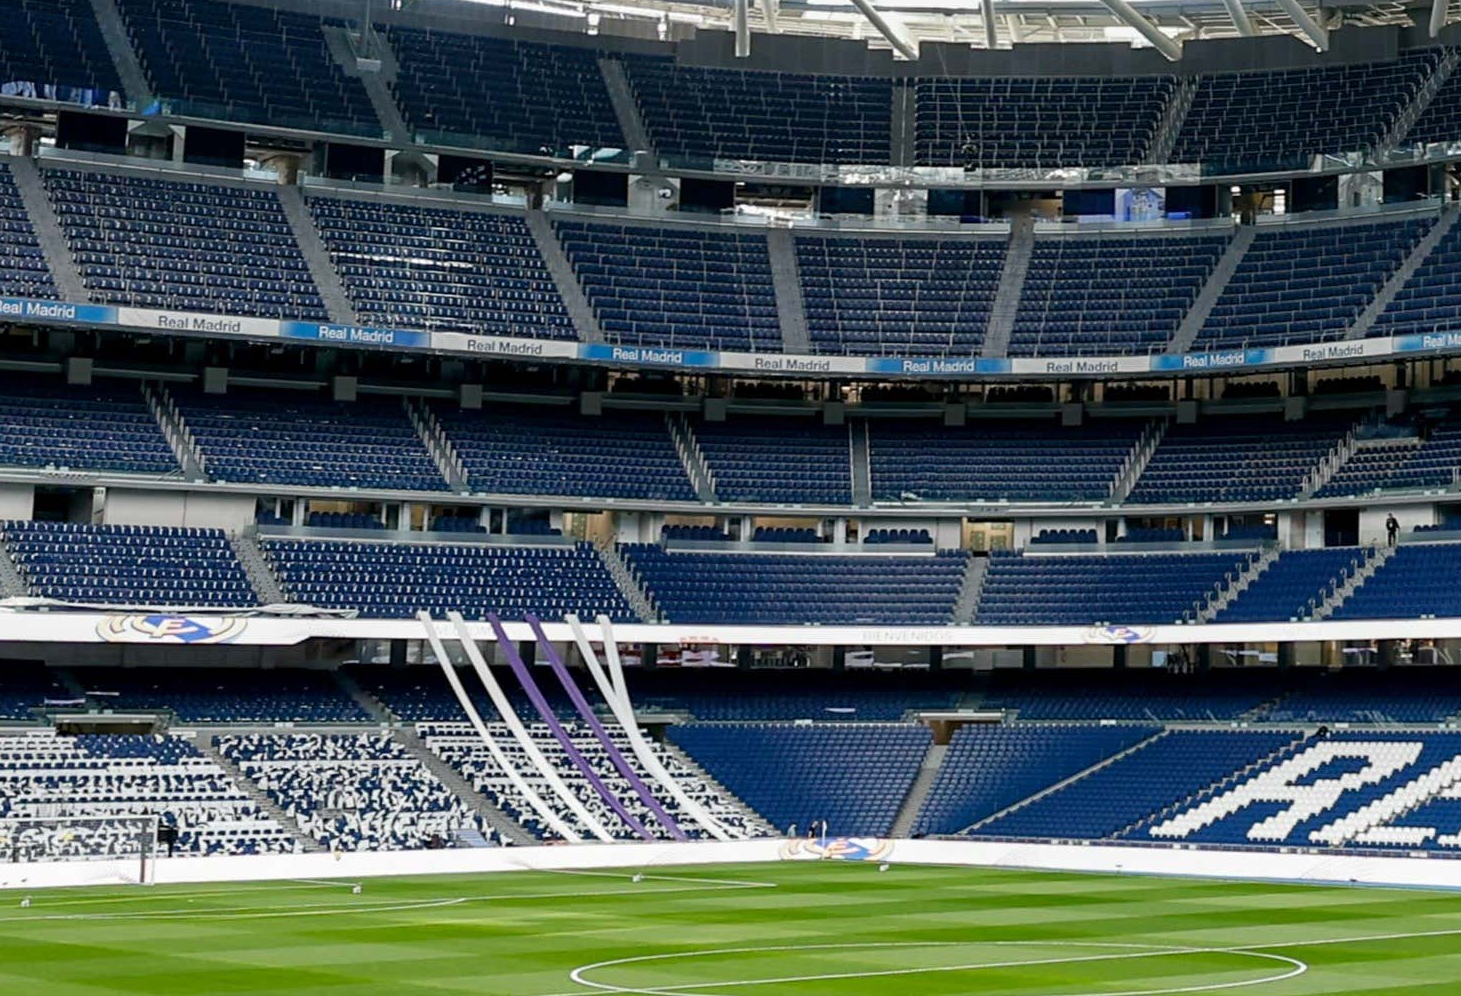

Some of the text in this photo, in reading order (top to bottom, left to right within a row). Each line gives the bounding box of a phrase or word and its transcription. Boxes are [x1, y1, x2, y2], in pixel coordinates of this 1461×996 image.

[27, 301, 75, 319] Madrid
[158, 315, 241, 333] Real Madrid
[318, 325, 393, 344] Real Madrid
[1423, 333, 1447, 348] Real
[467, 338, 542, 355] Real Madrid
[612, 347, 681, 363] Real Madrid
[1303, 344, 1363, 362] Real Madrid
[755, 355, 830, 372] Real Madrid
[903, 358, 975, 373] Real Madrid
[1046, 360, 1118, 373] Real Madrid
[1183, 352, 1245, 368] Real Madrid
